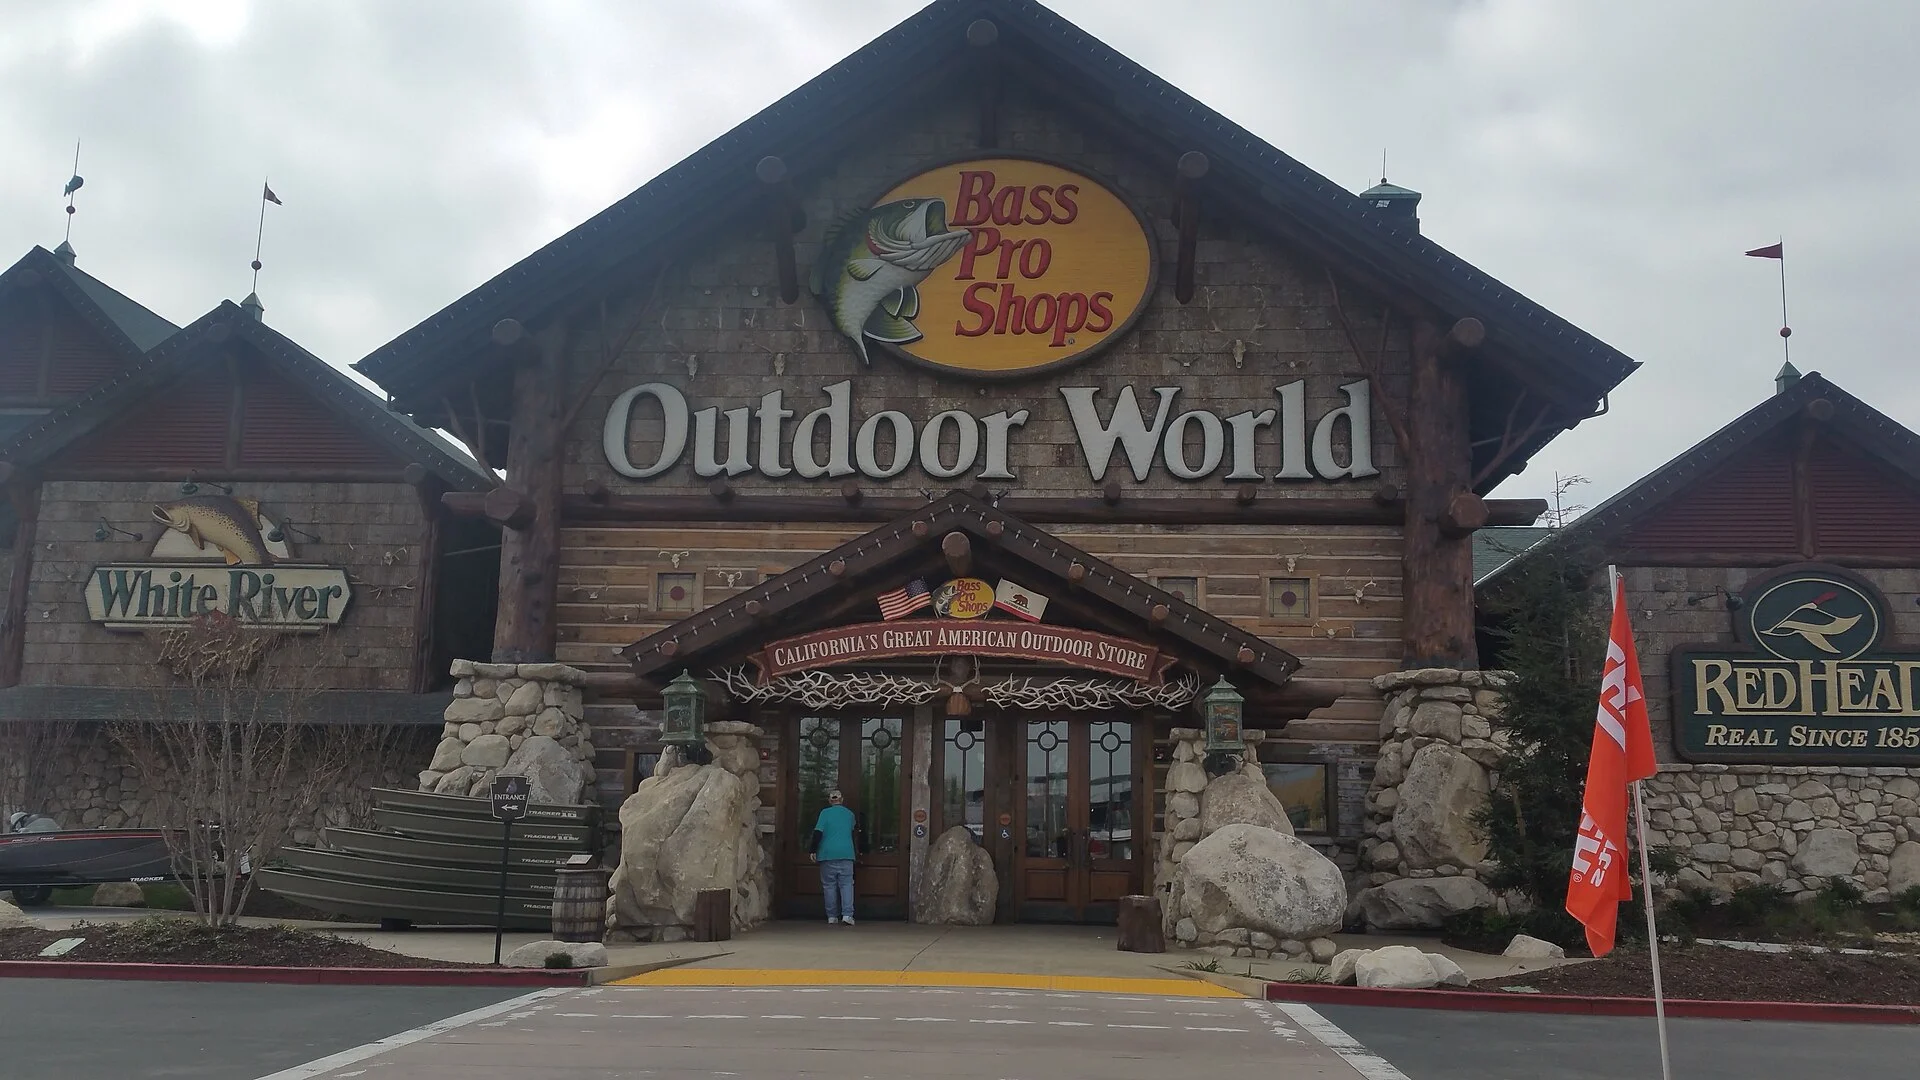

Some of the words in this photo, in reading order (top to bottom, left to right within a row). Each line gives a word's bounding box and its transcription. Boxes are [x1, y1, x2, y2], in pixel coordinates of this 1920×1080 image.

[949, 171, 1079, 227] Bass
[955, 227, 1052, 280] Pro
[955, 282, 1114, 348] Shops
[603, 379, 1029, 480] Outdoor
[1060, 378, 1380, 482] World
[94, 569, 218, 619] White
[228, 569, 342, 621] River
[957, 580, 981, 591] Bass
[957, 601, 988, 614] Shops
[959, 591, 976, 601] Pro
[774, 633, 879, 667] CALIFORNIA'S
[882, 630, 933, 649] GREAT
[936, 627, 1017, 649] AMERICAN
[1020, 630, 1093, 659] OUTDOOR
[1096, 641, 1148, 670] STORE
[1705, 724, 1778, 747] REAL
[1788, 725, 1868, 748] SINCE
